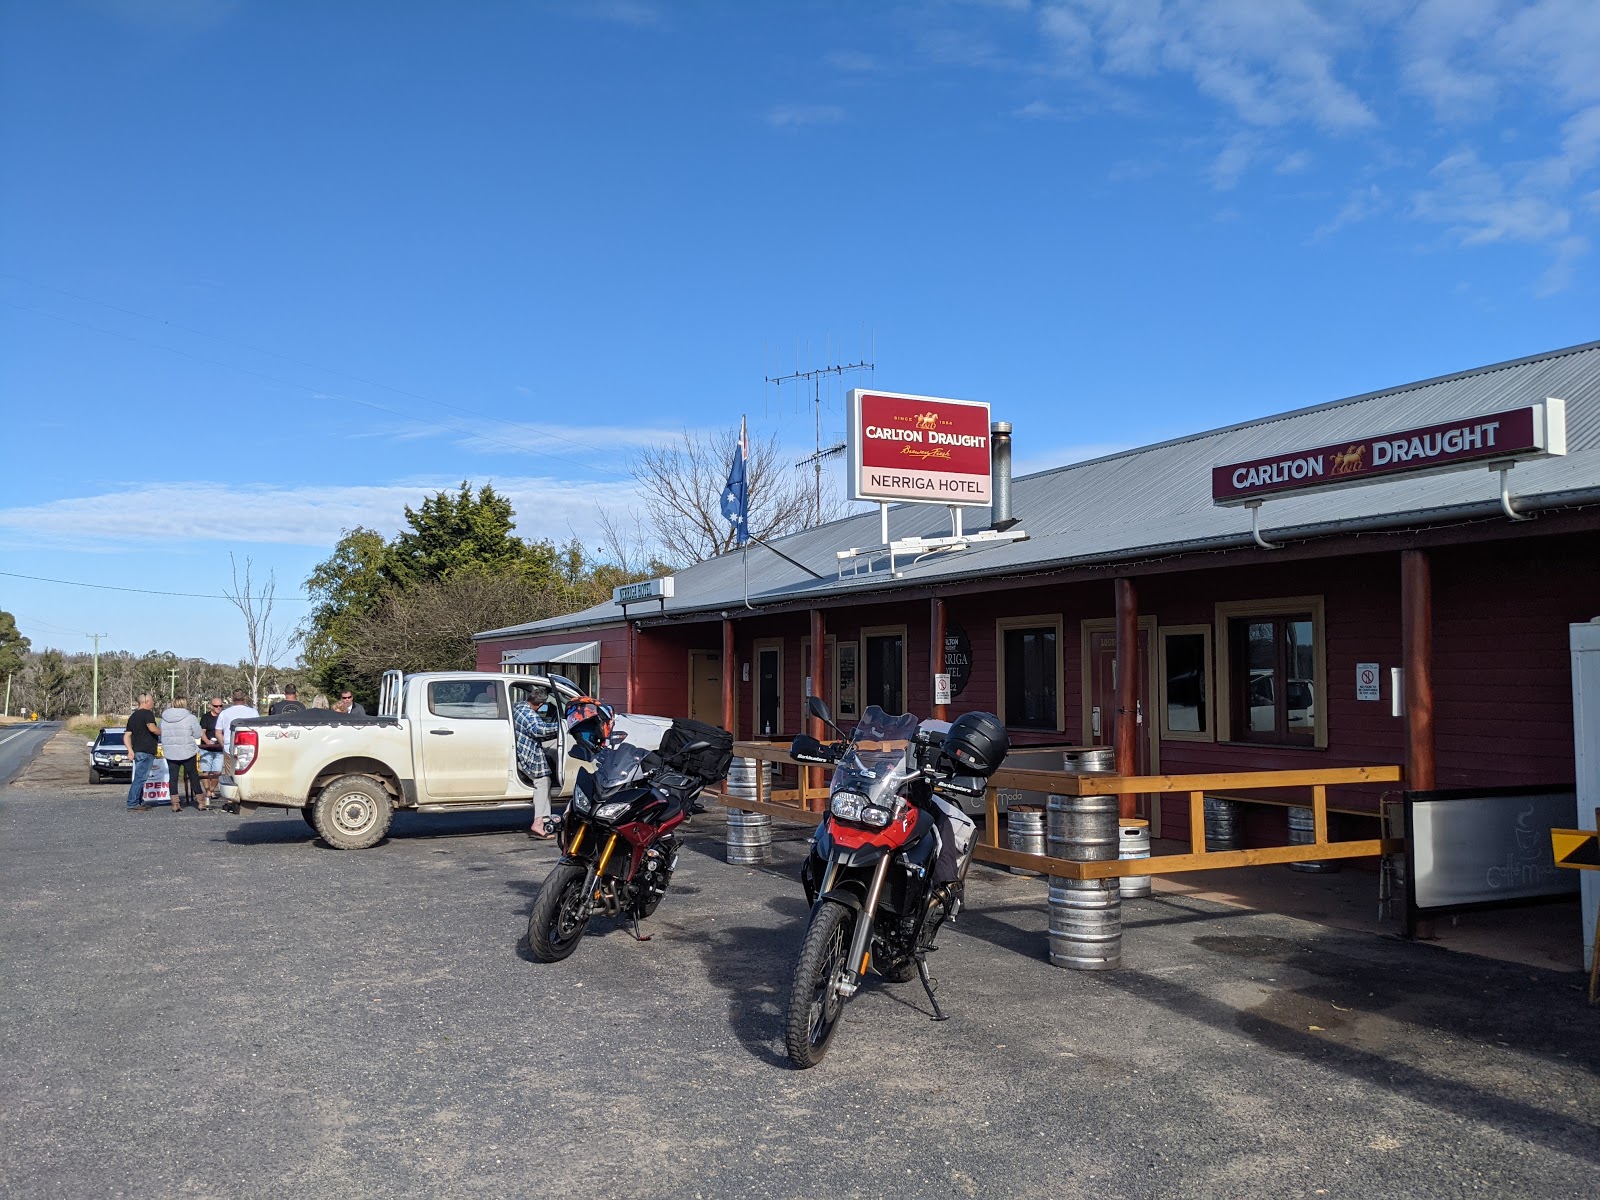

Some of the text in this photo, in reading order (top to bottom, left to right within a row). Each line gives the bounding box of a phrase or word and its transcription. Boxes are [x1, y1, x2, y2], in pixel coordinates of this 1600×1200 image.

[866, 426, 987, 448] CARLTON DRAUGHT
[1232, 422, 1499, 490] CARLTON DRAUGHT
[871, 474, 984, 493] NERRIGA HOTEL
